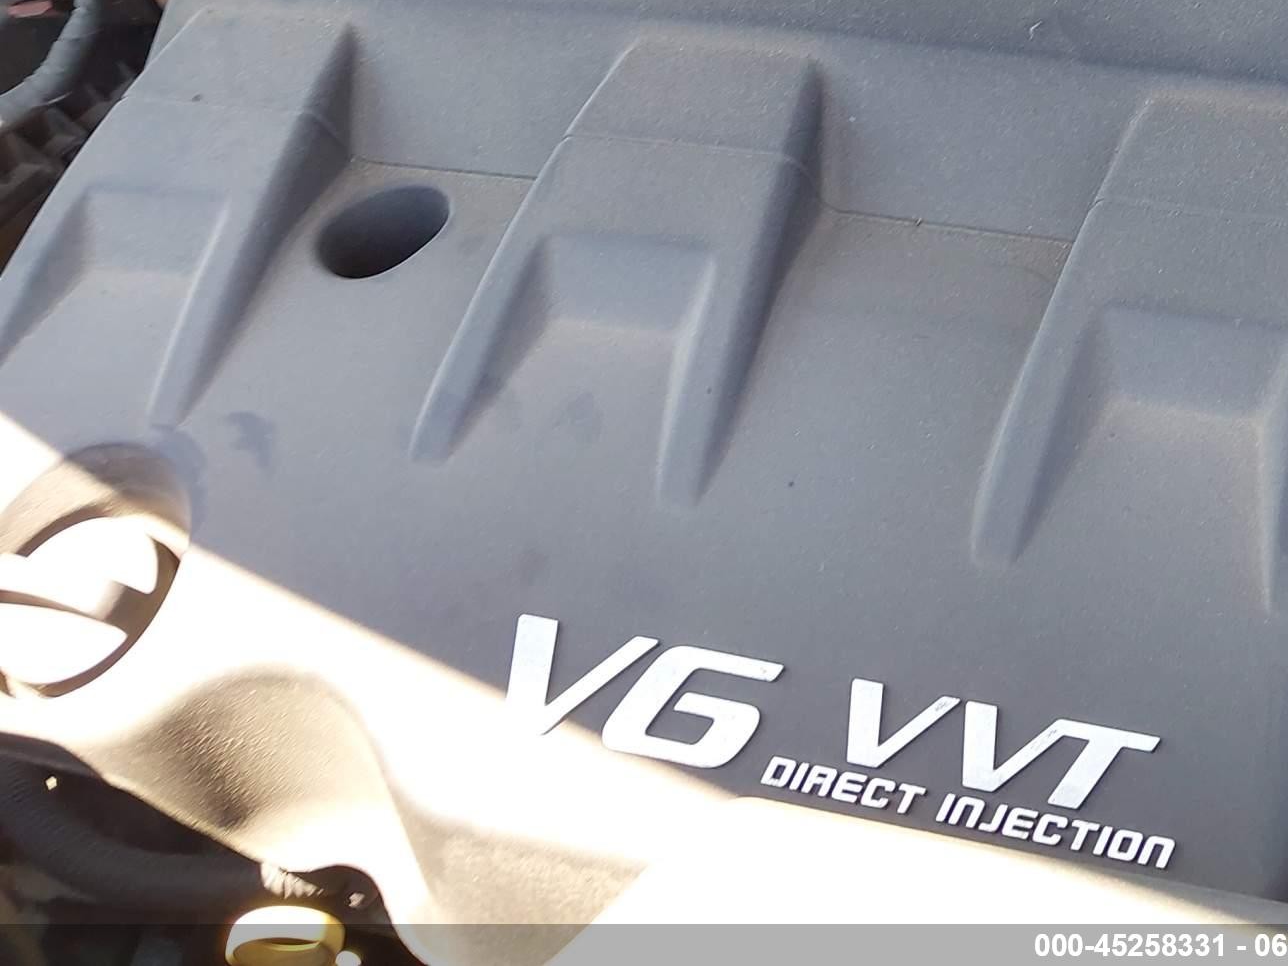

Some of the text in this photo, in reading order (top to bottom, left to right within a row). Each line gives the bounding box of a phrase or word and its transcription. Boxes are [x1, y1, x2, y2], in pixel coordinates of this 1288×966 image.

[846, 677, 1162, 810] VVT
[760, 755, 1177, 871] DIRECT INJECTION
